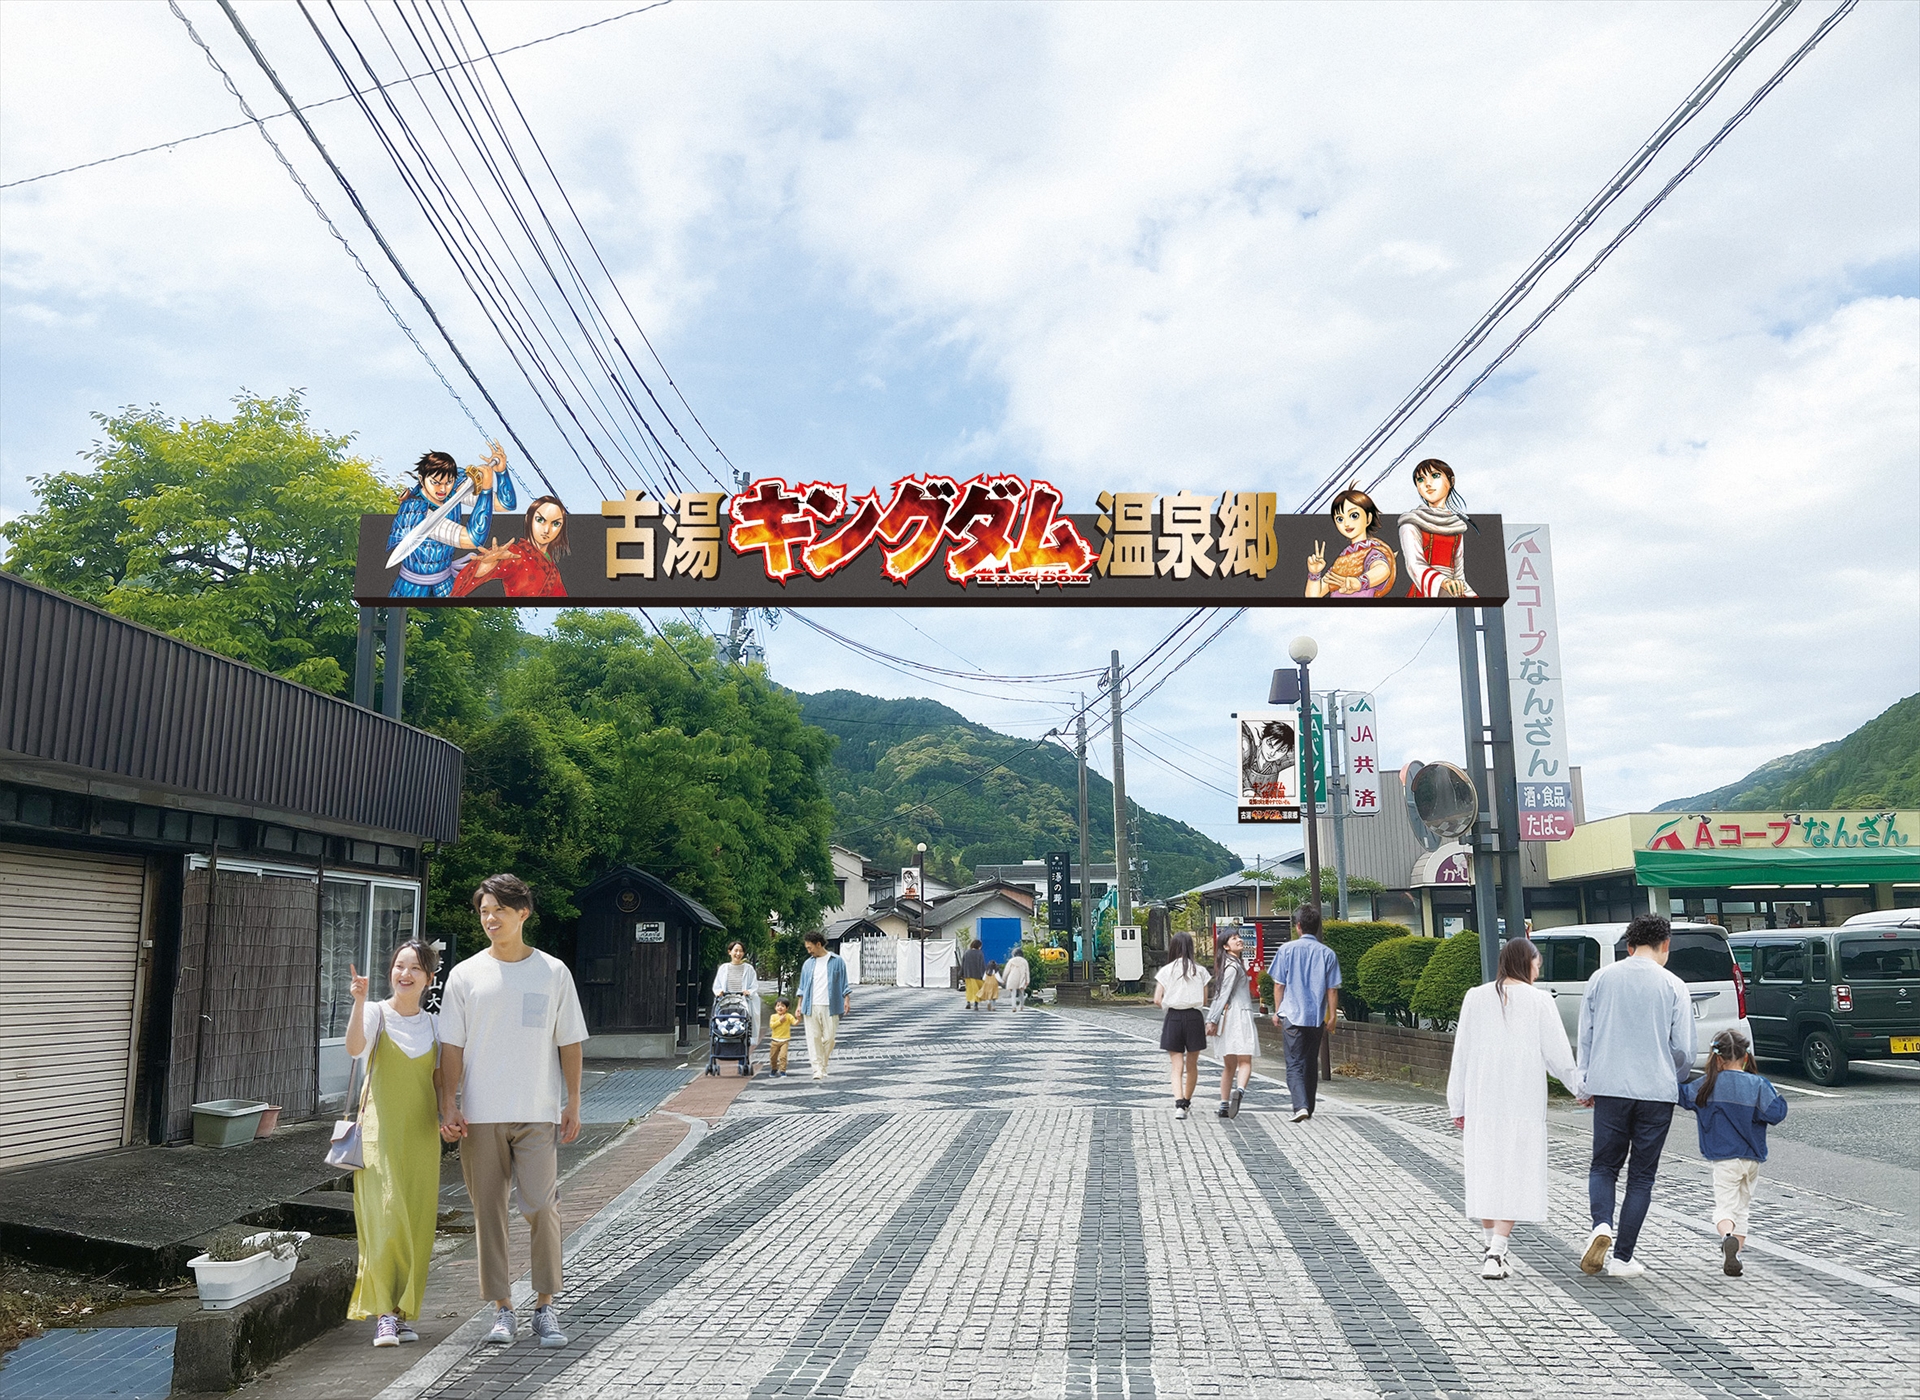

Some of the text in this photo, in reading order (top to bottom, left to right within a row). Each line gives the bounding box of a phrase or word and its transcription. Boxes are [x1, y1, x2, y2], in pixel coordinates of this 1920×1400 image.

[978, 573, 1090, 585] KINGDOM
[1526, 814, 1567, 837] たばこ
